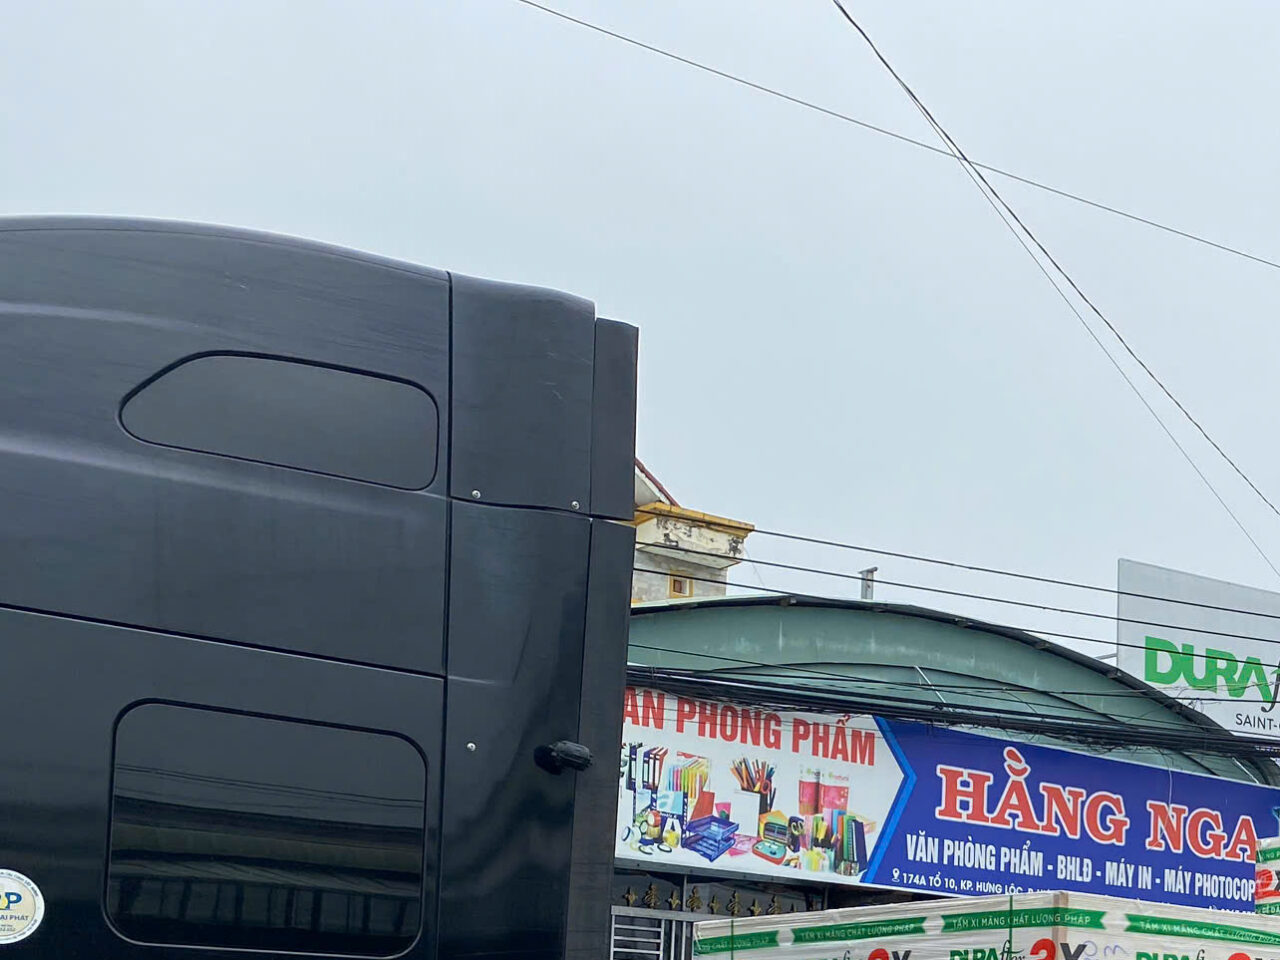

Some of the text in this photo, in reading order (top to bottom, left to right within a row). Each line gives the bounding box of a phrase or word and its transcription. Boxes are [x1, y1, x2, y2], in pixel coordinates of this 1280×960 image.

[936, 748, 1256, 864] HẰNG NGA
[903, 873, 926, 886] 174A
[929, 871, 941, 887] TỔ
[960, 880, 973, 891] KP.
[976, 881, 1002, 894] HƯNG
[906, 830, 939, 864] VĂN
[943, 835, 996, 871] PHÒNG
[1000, 840, 1043, 877] PHẨM
[1057, 855, 1092, 882] BHLĐ
[1105, 858, 1135, 887] MÁY
[1138, 866, 1152, 889] IN
[1164, 866, 1192, 894] MÁY
[1195, 872, 1255, 902] PHOTOCOP
